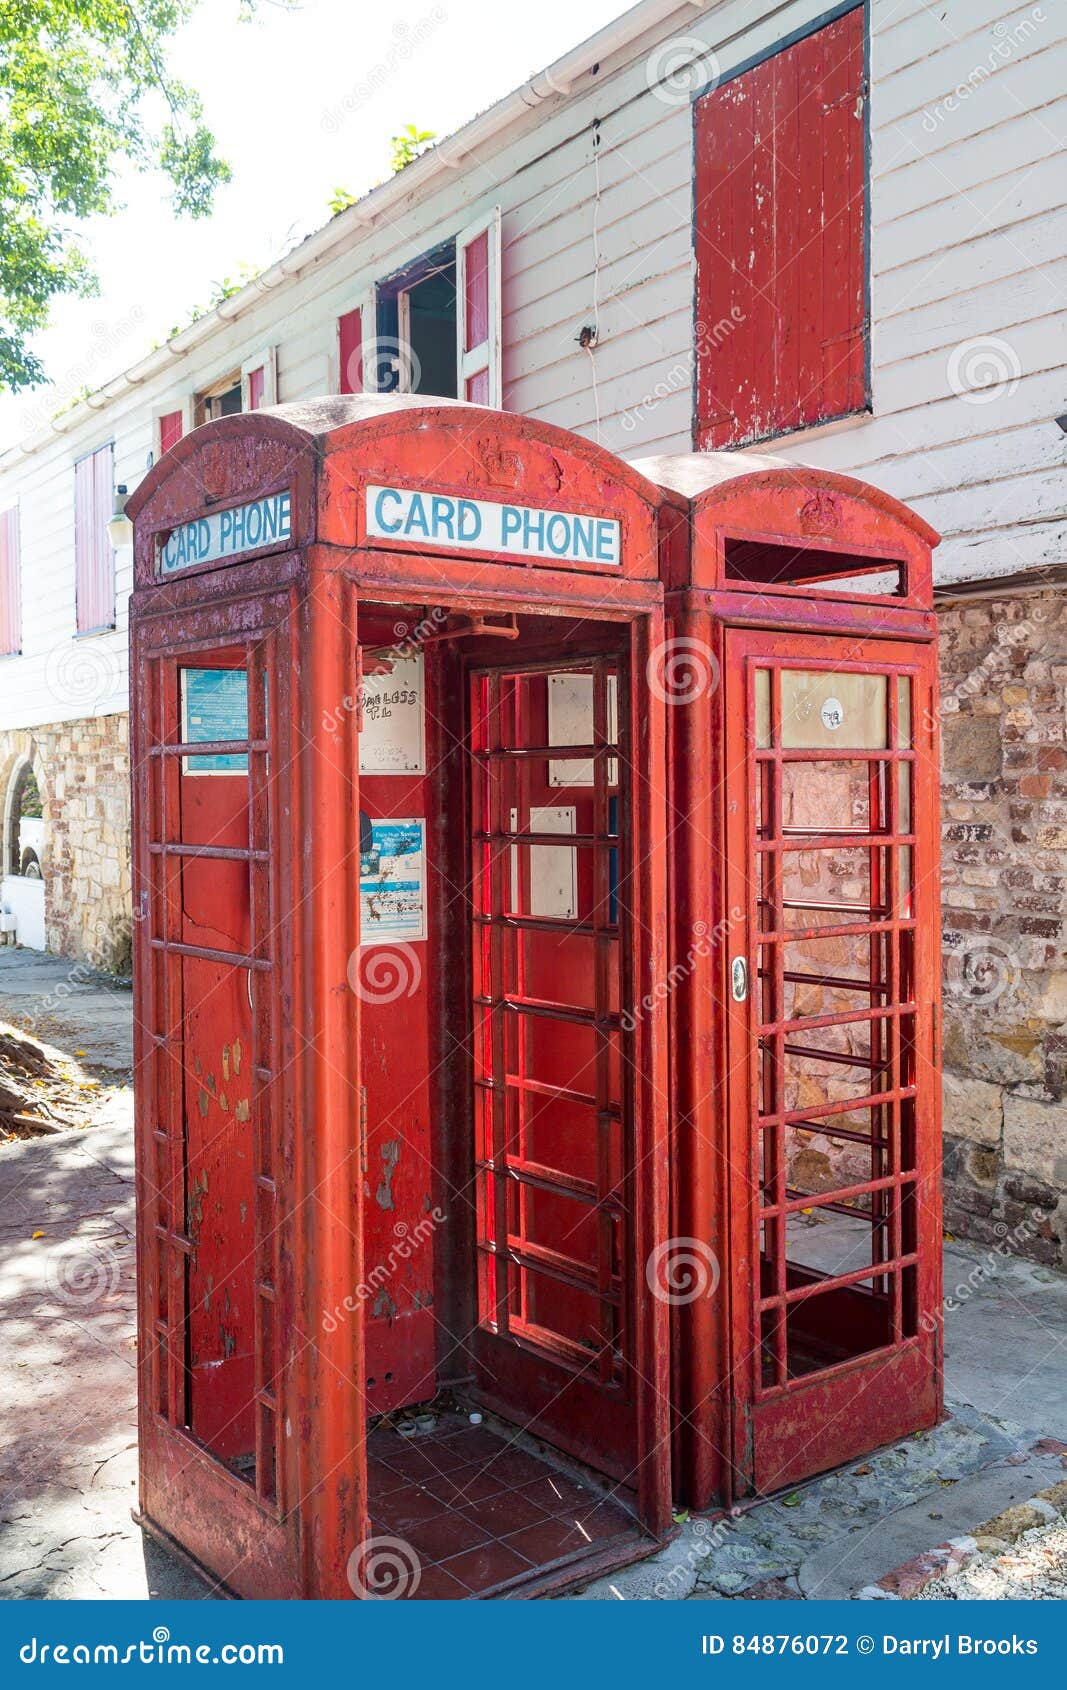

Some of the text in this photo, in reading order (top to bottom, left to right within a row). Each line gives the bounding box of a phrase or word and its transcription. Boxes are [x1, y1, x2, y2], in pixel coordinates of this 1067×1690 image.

[164, 493, 291, 568] CARD PHONE
[375, 489, 614, 560] CARD PHONE
